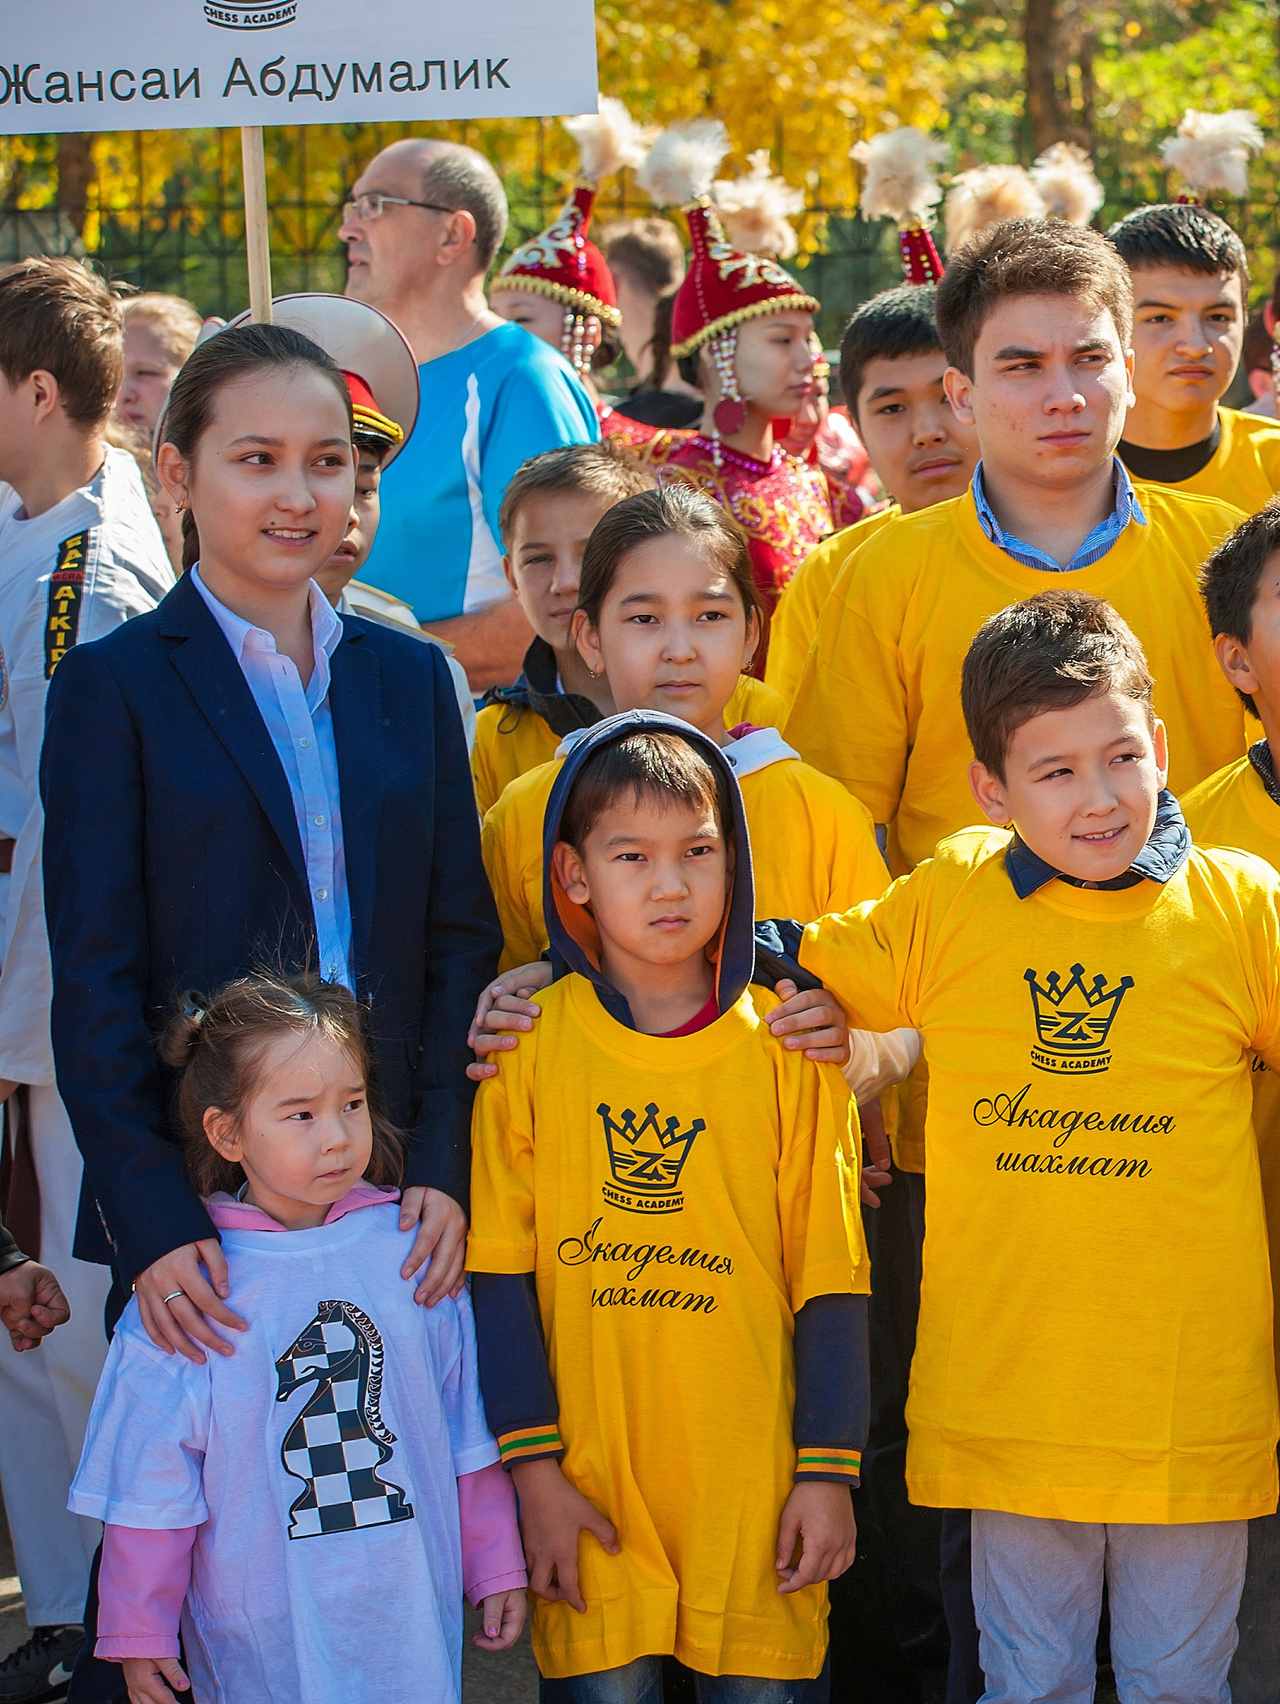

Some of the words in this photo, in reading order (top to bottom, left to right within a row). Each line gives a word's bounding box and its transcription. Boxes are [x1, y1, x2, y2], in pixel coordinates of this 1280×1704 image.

[203, 5, 239, 23] CHESS
[243, 2, 299, 24] ACADEMY
[222, 55, 512, 103] Абдумалик
[1030, 1050, 1057, 1067] CHESS
[1060, 1054, 1113, 1069] ACADEMY
[973, 1083, 1177, 1149] Академия
[995, 1152, 1153, 1178] шахмат
[601, 1186, 633, 1206] CHESS
[636, 1196, 685, 1210] ACADEMY
